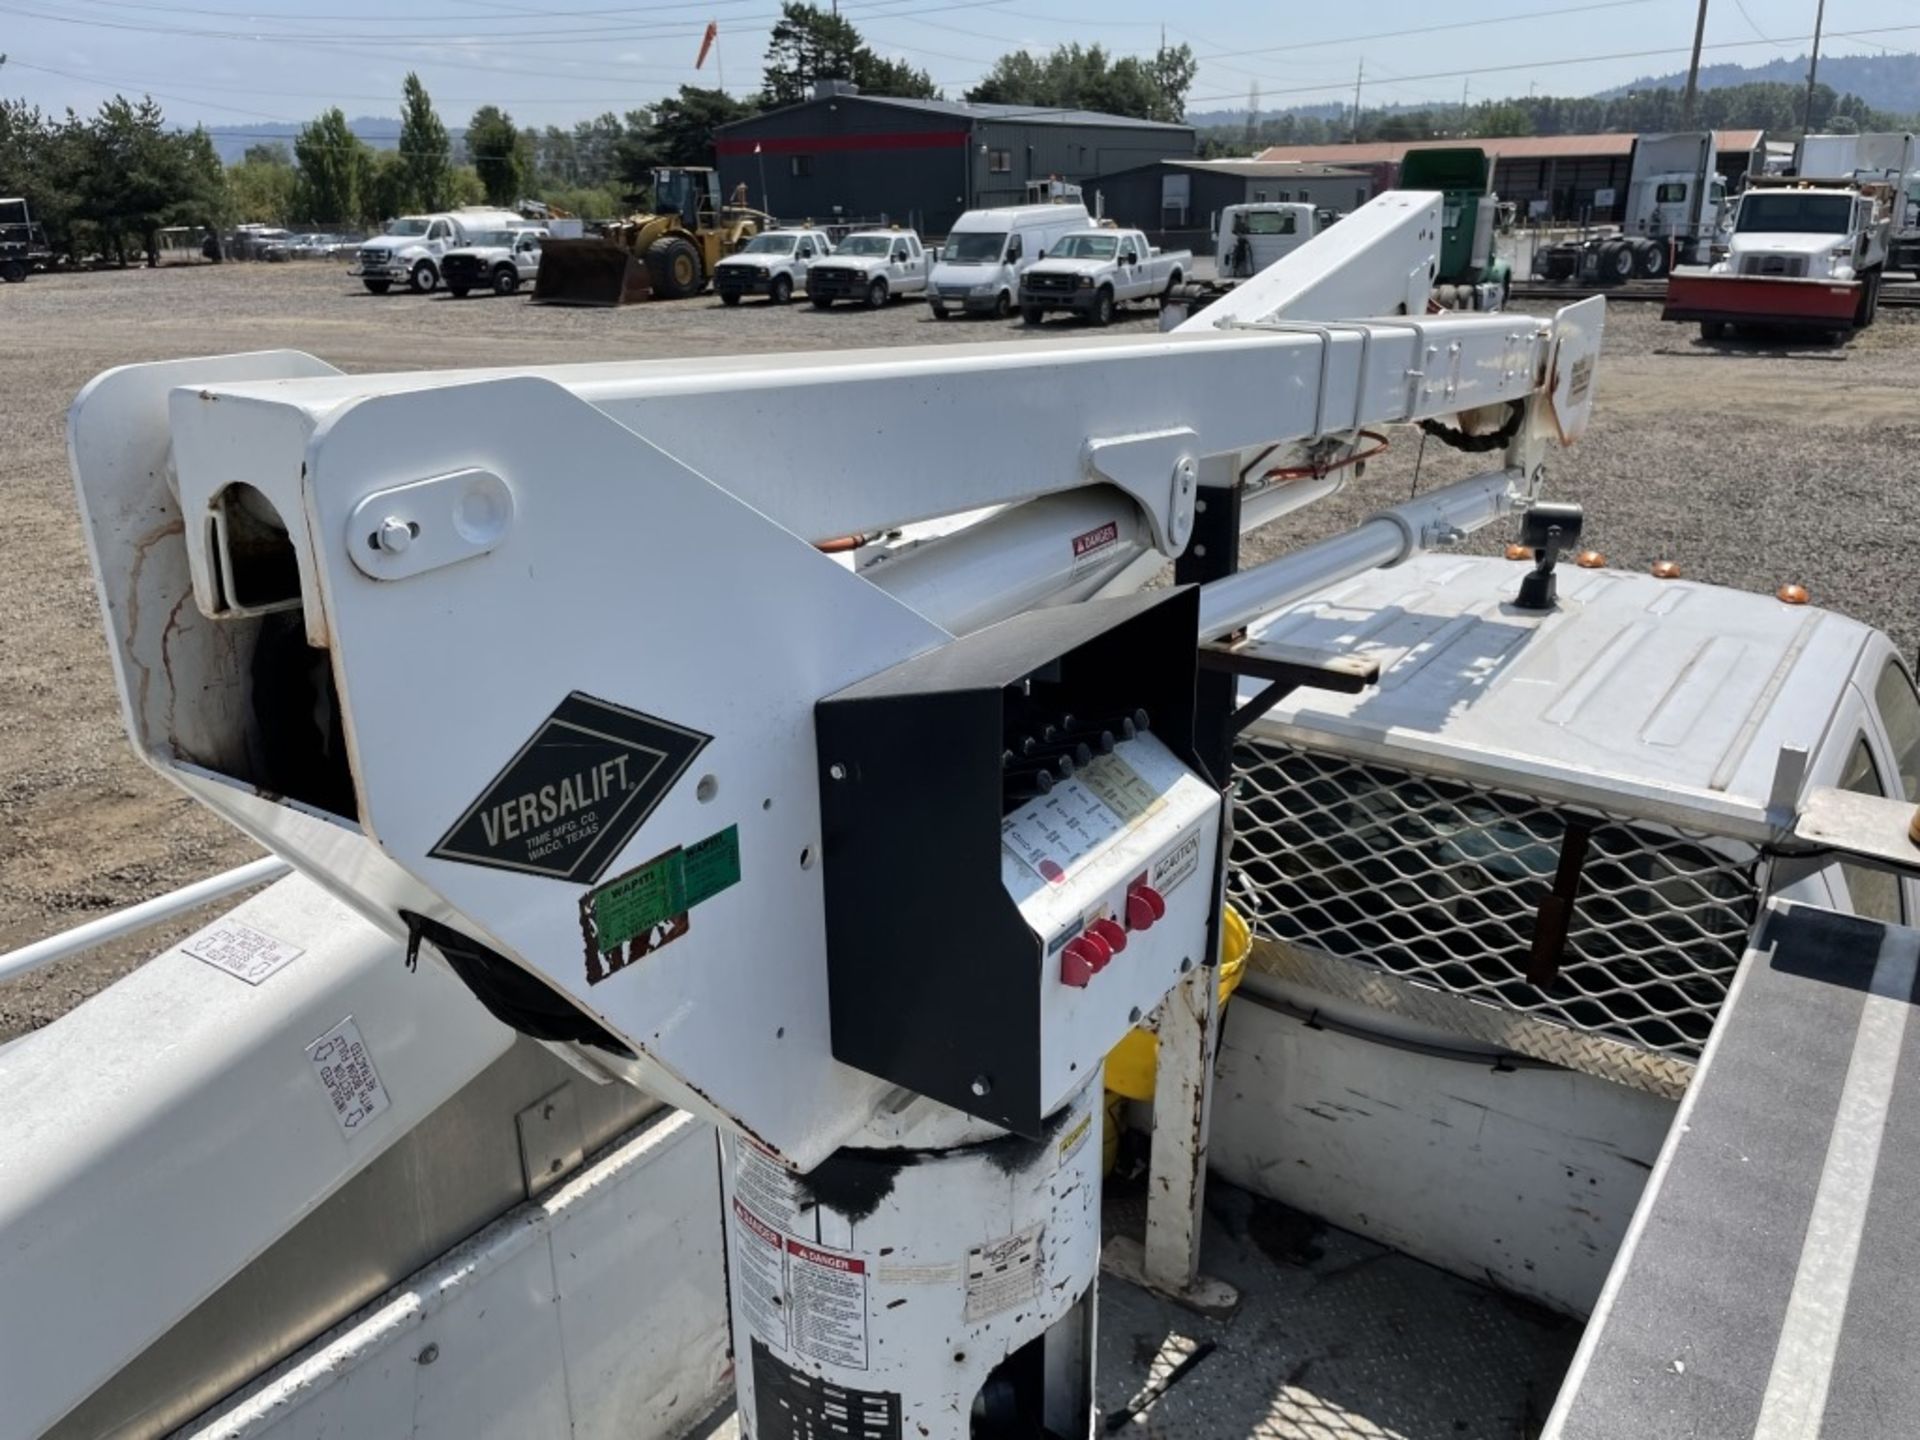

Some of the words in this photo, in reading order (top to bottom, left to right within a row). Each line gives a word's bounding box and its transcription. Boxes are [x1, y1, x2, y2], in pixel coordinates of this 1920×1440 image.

[480, 752, 629, 847] VERSALIFT
[526, 829, 551, 850] TIME
[580, 811, 599, 826] CO.
[565, 821, 599, 845] TEXAS
[610, 870, 655, 898] WAPITI
[809, 1252, 849, 1271] DANGER
